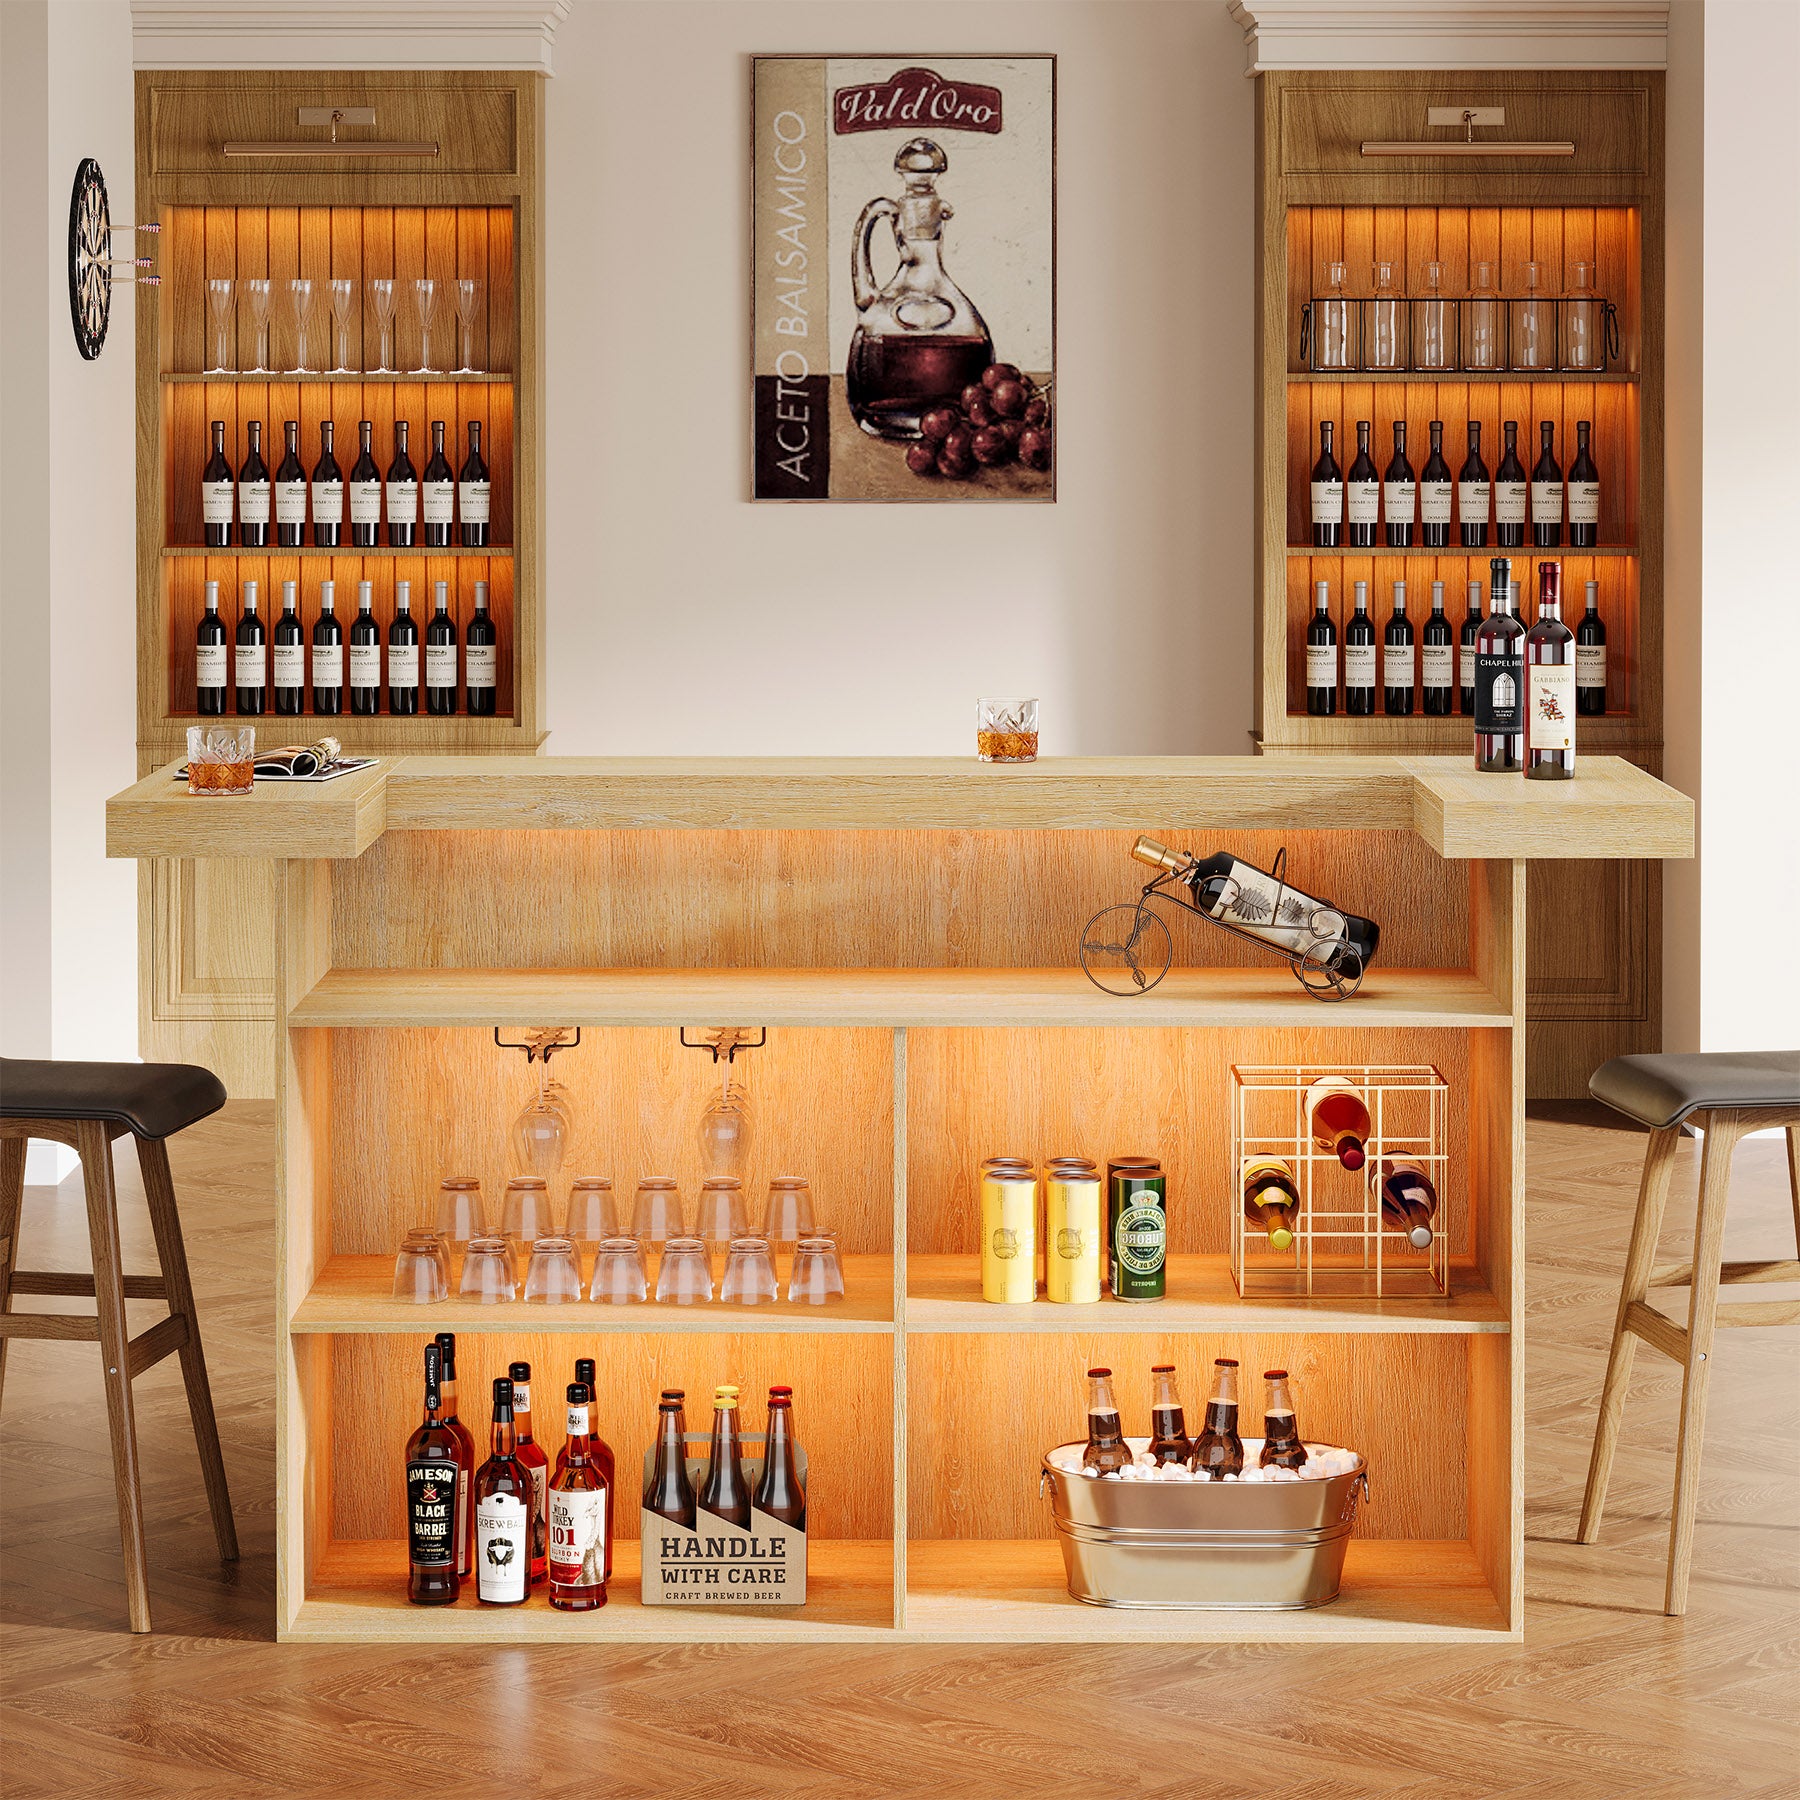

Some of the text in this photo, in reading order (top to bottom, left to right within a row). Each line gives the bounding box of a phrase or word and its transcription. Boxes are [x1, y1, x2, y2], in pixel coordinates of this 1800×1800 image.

[773, 111, 810, 482] ACETO BALSAMICO
[1480, 658, 1511, 667] CHAPEL
[1533, 676, 1570, 684] GABBIANO
[408, 1468, 454, 1483] JAMESON
[415, 1504, 446, 1518] BLACK
[414, 1522, 447, 1536] BARREL
[552, 1526, 577, 1546] 101
[660, 1537, 786, 1558] HANDLE
[661, 1568, 786, 1584] WITH CARE
[665, 1592, 782, 1600] CRAFT BREWED BEER
